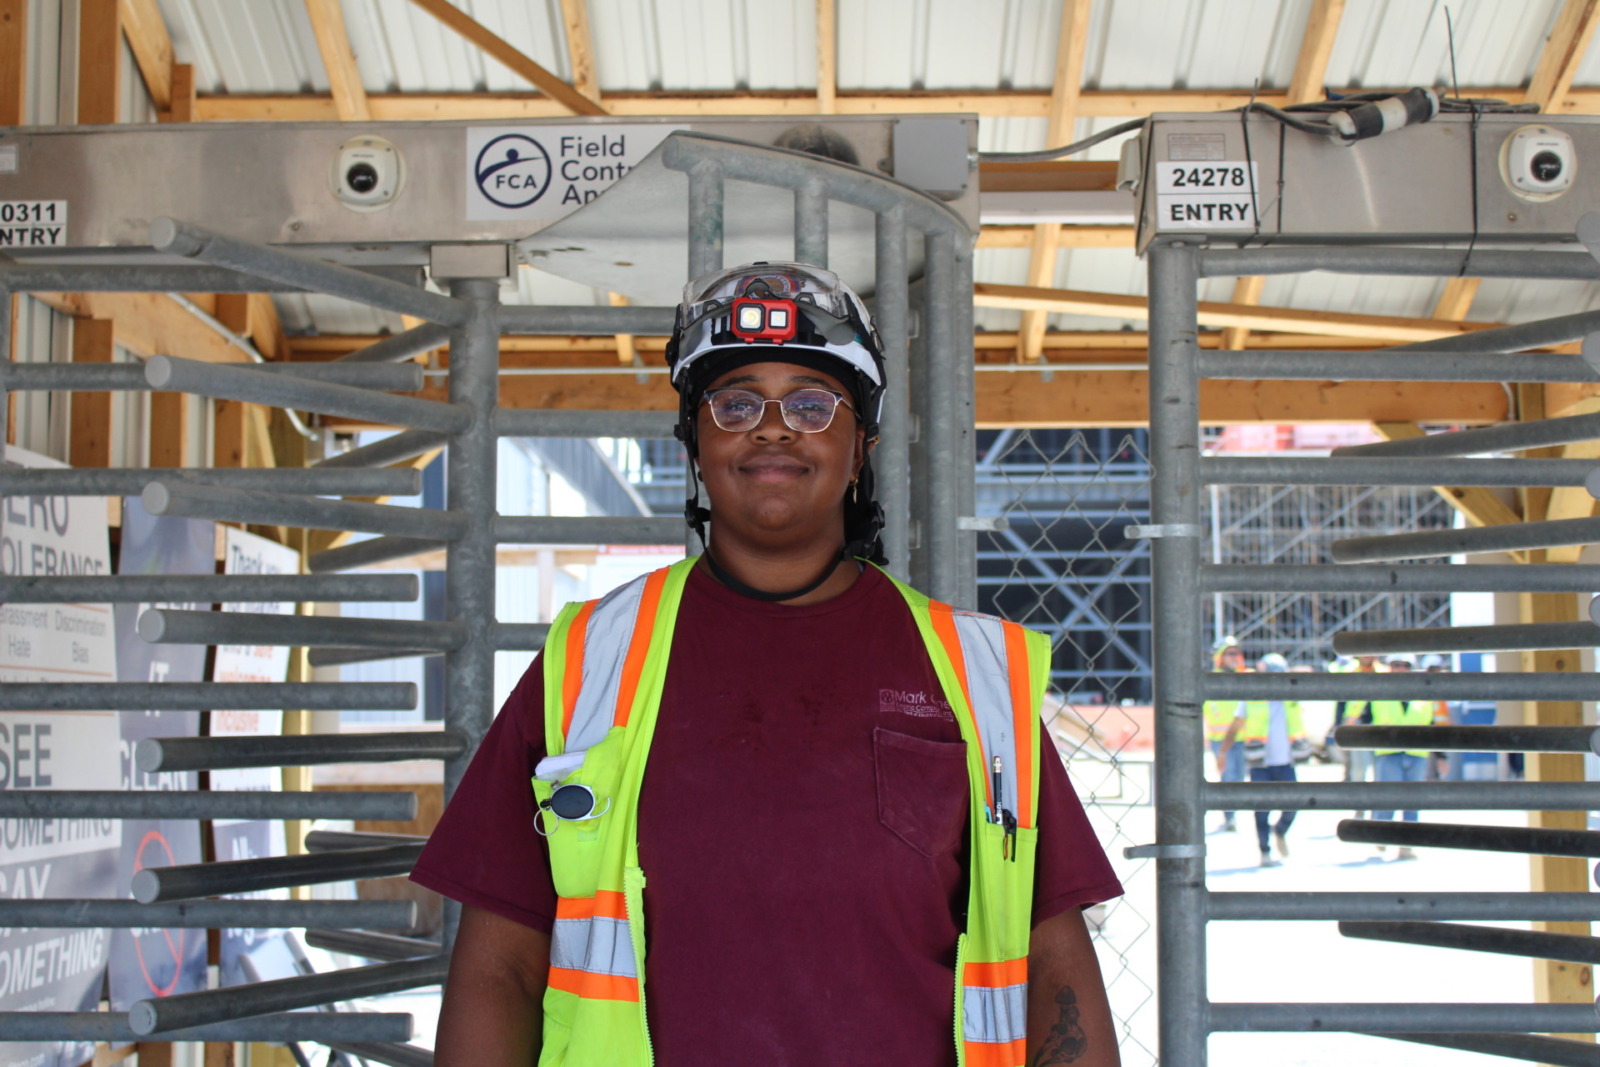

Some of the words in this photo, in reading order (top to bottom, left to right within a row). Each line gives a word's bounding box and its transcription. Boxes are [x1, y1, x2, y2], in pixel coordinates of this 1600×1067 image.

[560, 134, 625, 157] Field
[495, 174, 538, 190] FCA
[1172, 167, 1245, 187] 24278
[560, 184, 607, 206] An
[1170, 203, 1250, 221] ENTRY
[55, 609, 107, 637] Discrimination
[8, 633, 31, 658] Hate
[72, 640, 90, 664] Bias
[894, 690, 927, 705] Mark
[0, 721, 52, 788] SEE
